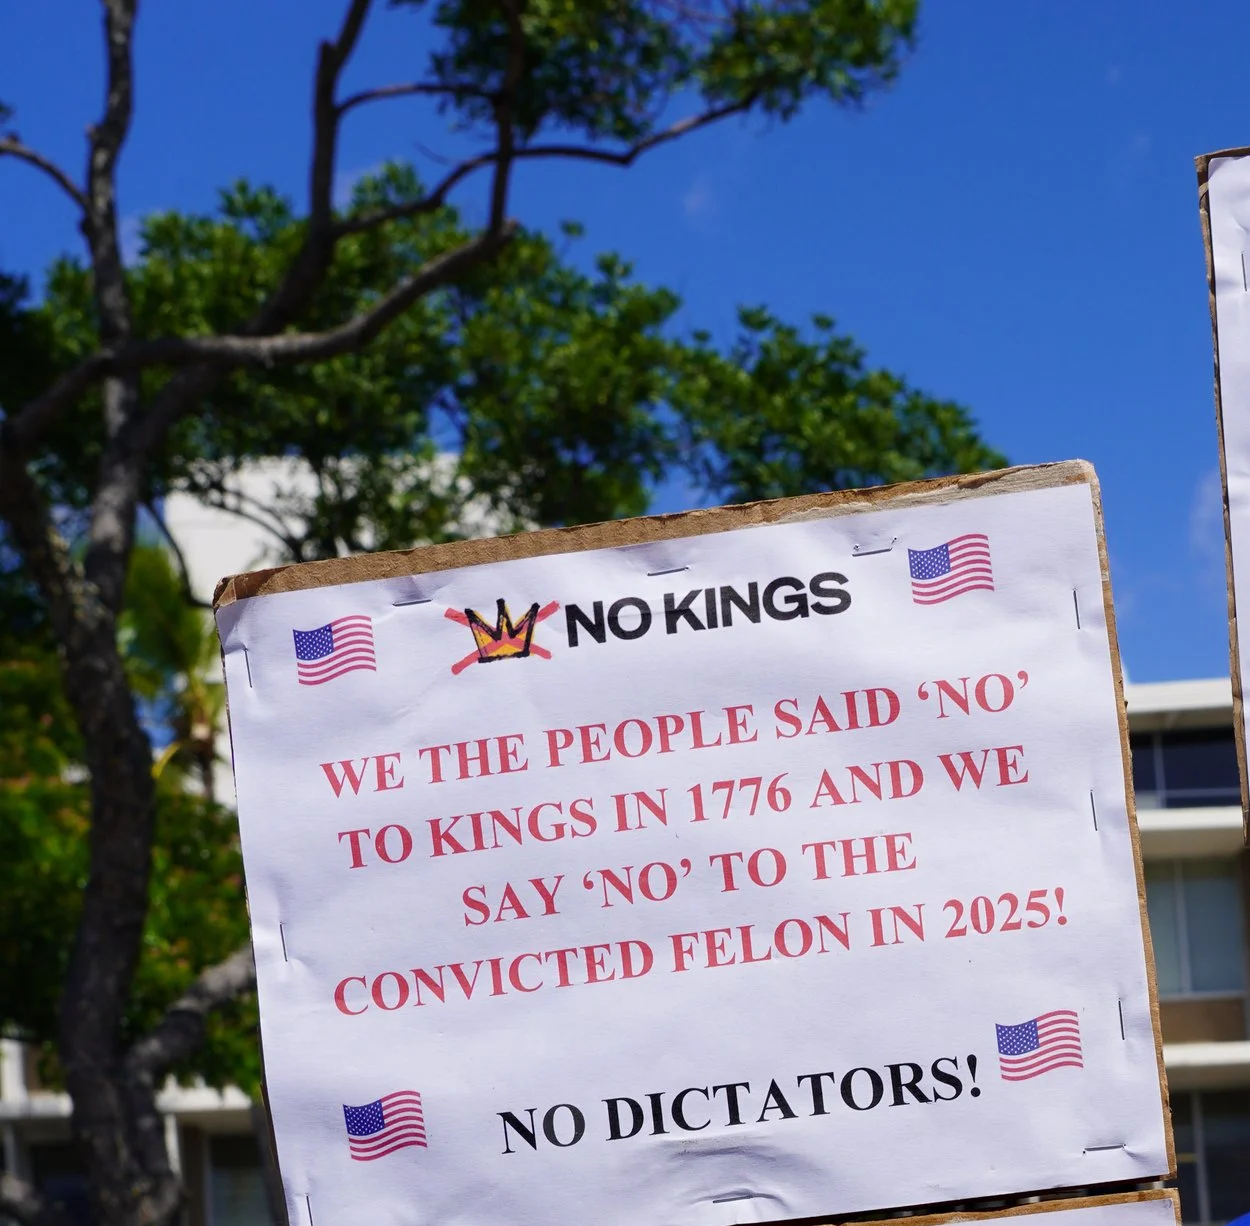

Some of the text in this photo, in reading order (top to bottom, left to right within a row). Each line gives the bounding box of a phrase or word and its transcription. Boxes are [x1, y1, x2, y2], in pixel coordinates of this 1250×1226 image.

[565, 572, 851, 648] NO KINGS
[320, 671, 1028, 798] WE THE PEOPLE SAID ‘NO’
[338, 745, 1028, 869] TO KINGS IN 1776 AND WE
[463, 833, 916, 926] SAY ‘NO’ TO THE
[334, 887, 1067, 1015] CONVICTED FELON IN 2025!
[496, 1054, 981, 1154] NO DICTATORS!
